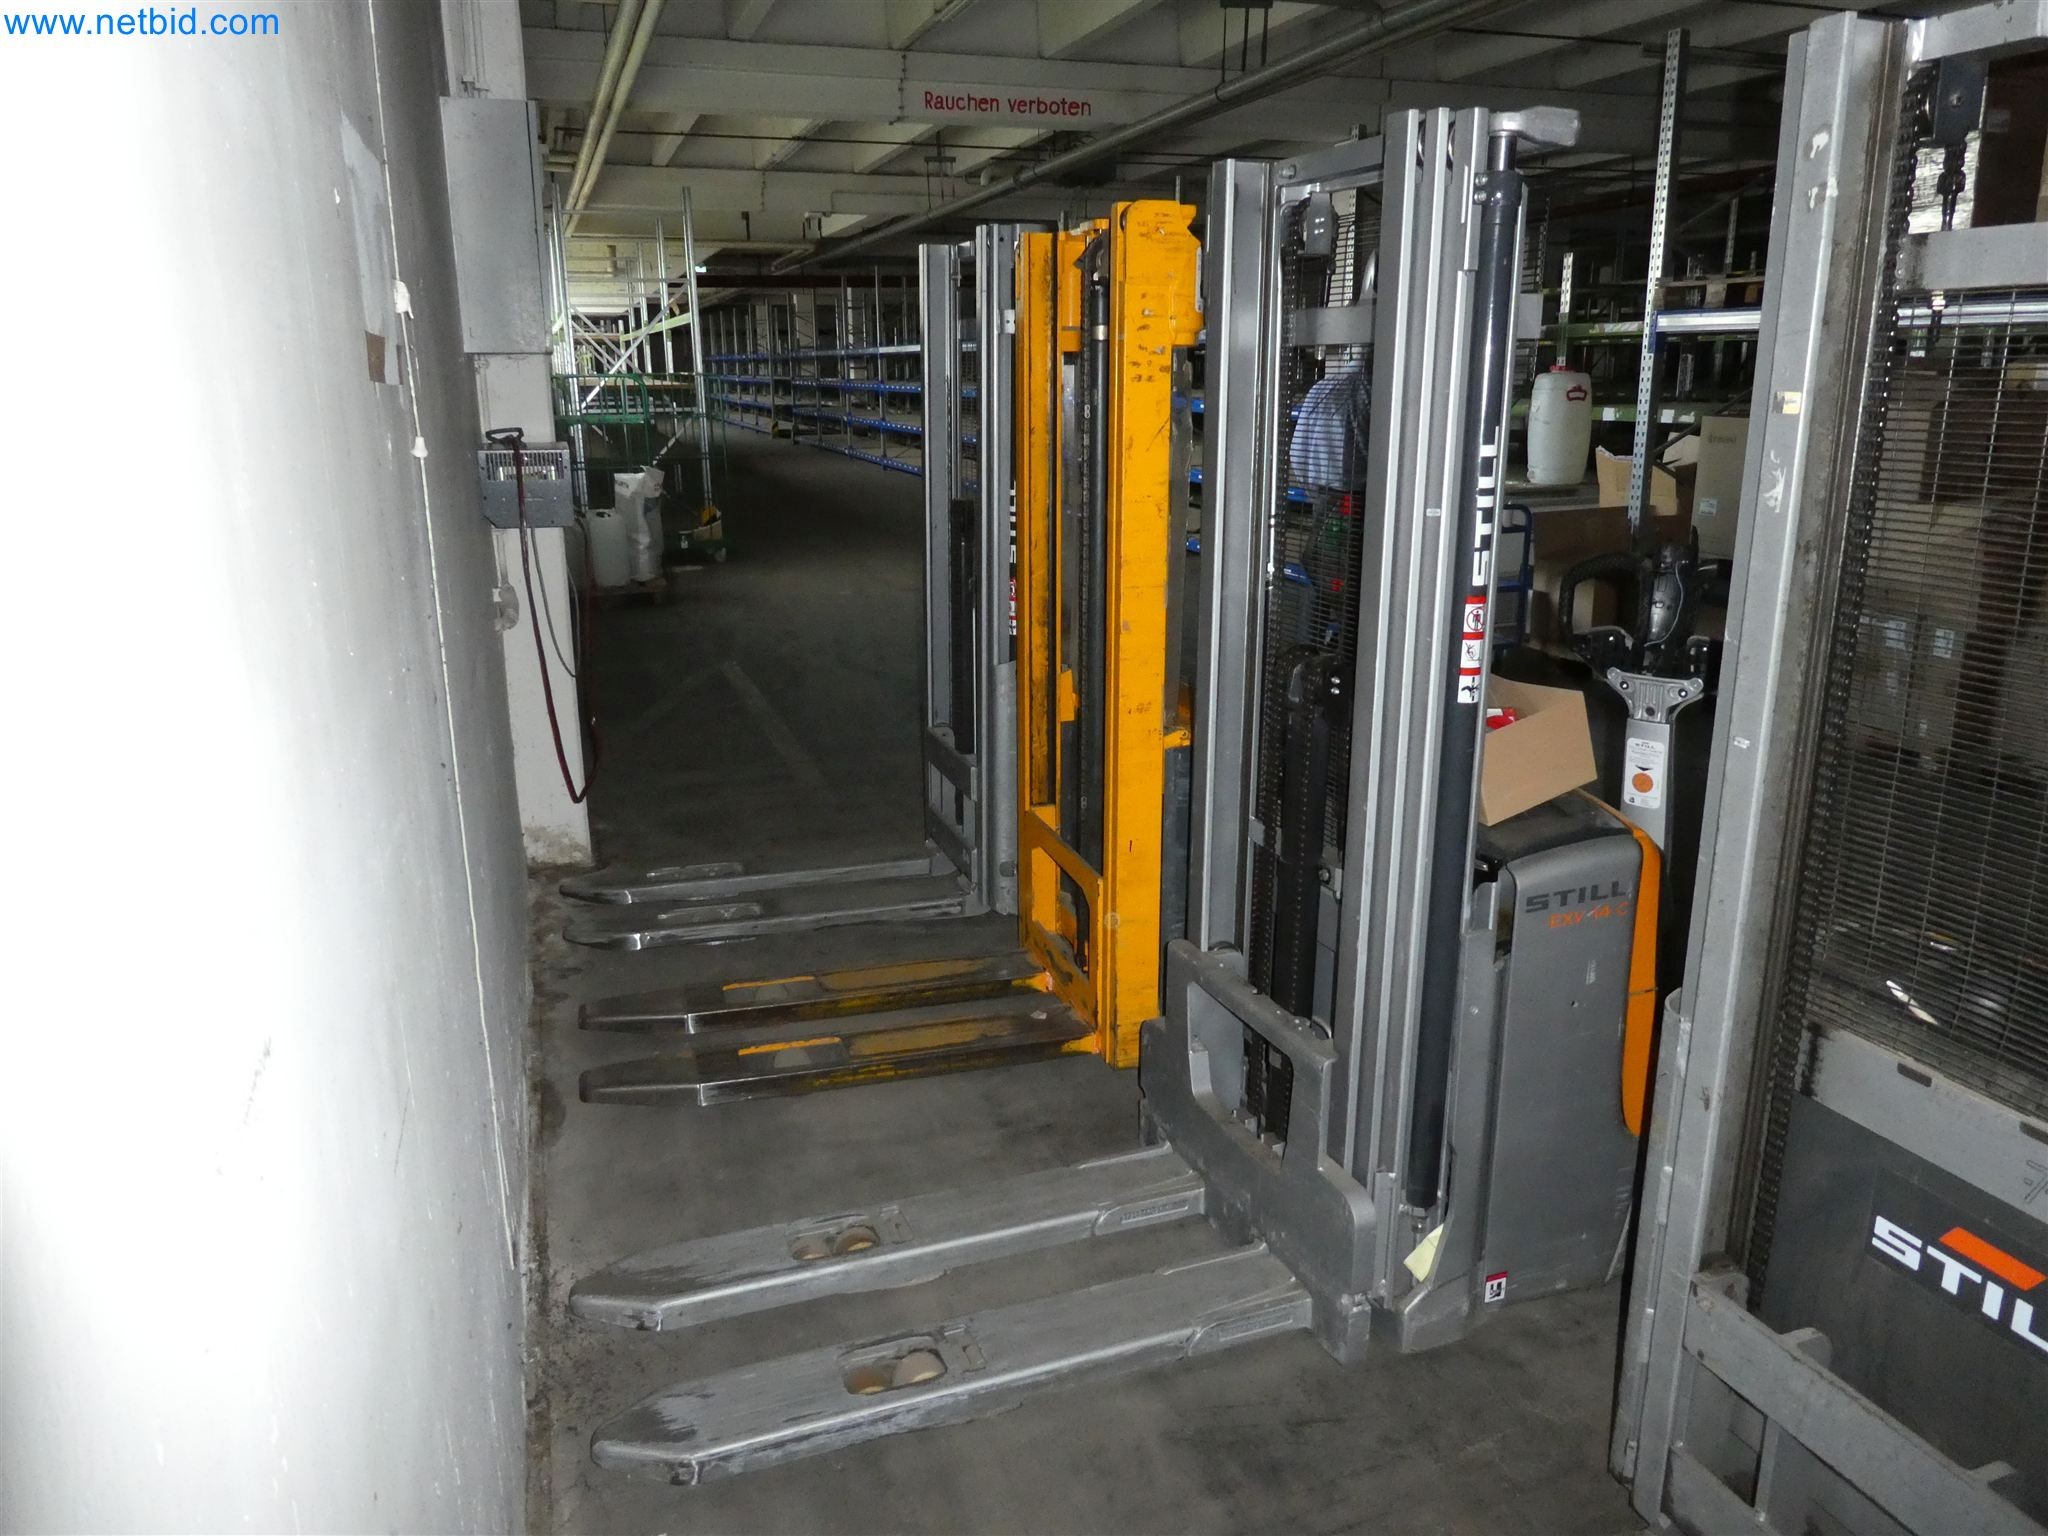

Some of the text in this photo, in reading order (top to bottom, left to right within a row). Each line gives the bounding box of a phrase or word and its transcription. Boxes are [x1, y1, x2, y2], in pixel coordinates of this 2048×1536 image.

[924, 91, 1092, 117] Rauchen verboten
[1472, 426, 1499, 587] STILL
[1525, 880, 1627, 914] STILL
[1549, 911, 1585, 929] EXV
